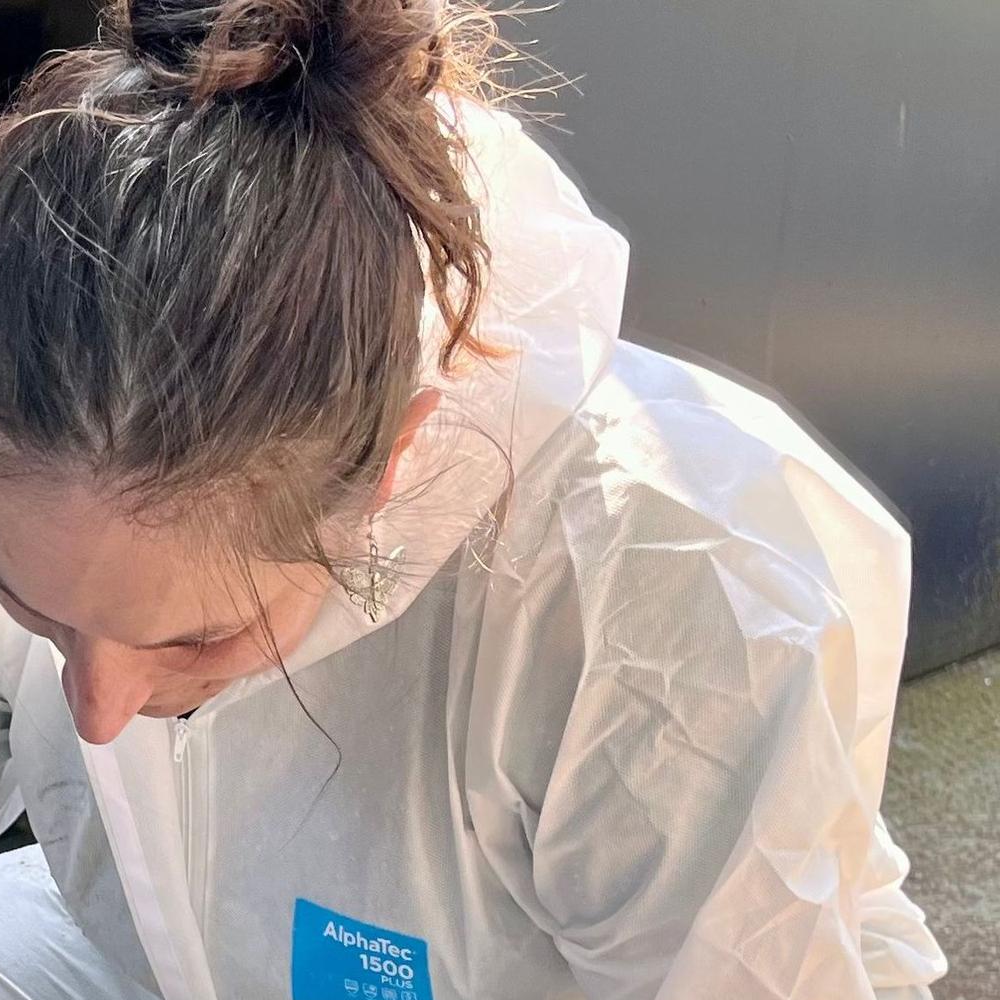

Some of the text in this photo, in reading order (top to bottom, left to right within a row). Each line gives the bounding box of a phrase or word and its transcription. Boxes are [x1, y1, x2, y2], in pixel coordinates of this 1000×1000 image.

[323, 921, 413, 961] AlphaTec
[360, 953, 414, 980] 1500
[381, 975, 414, 989] PLUS
